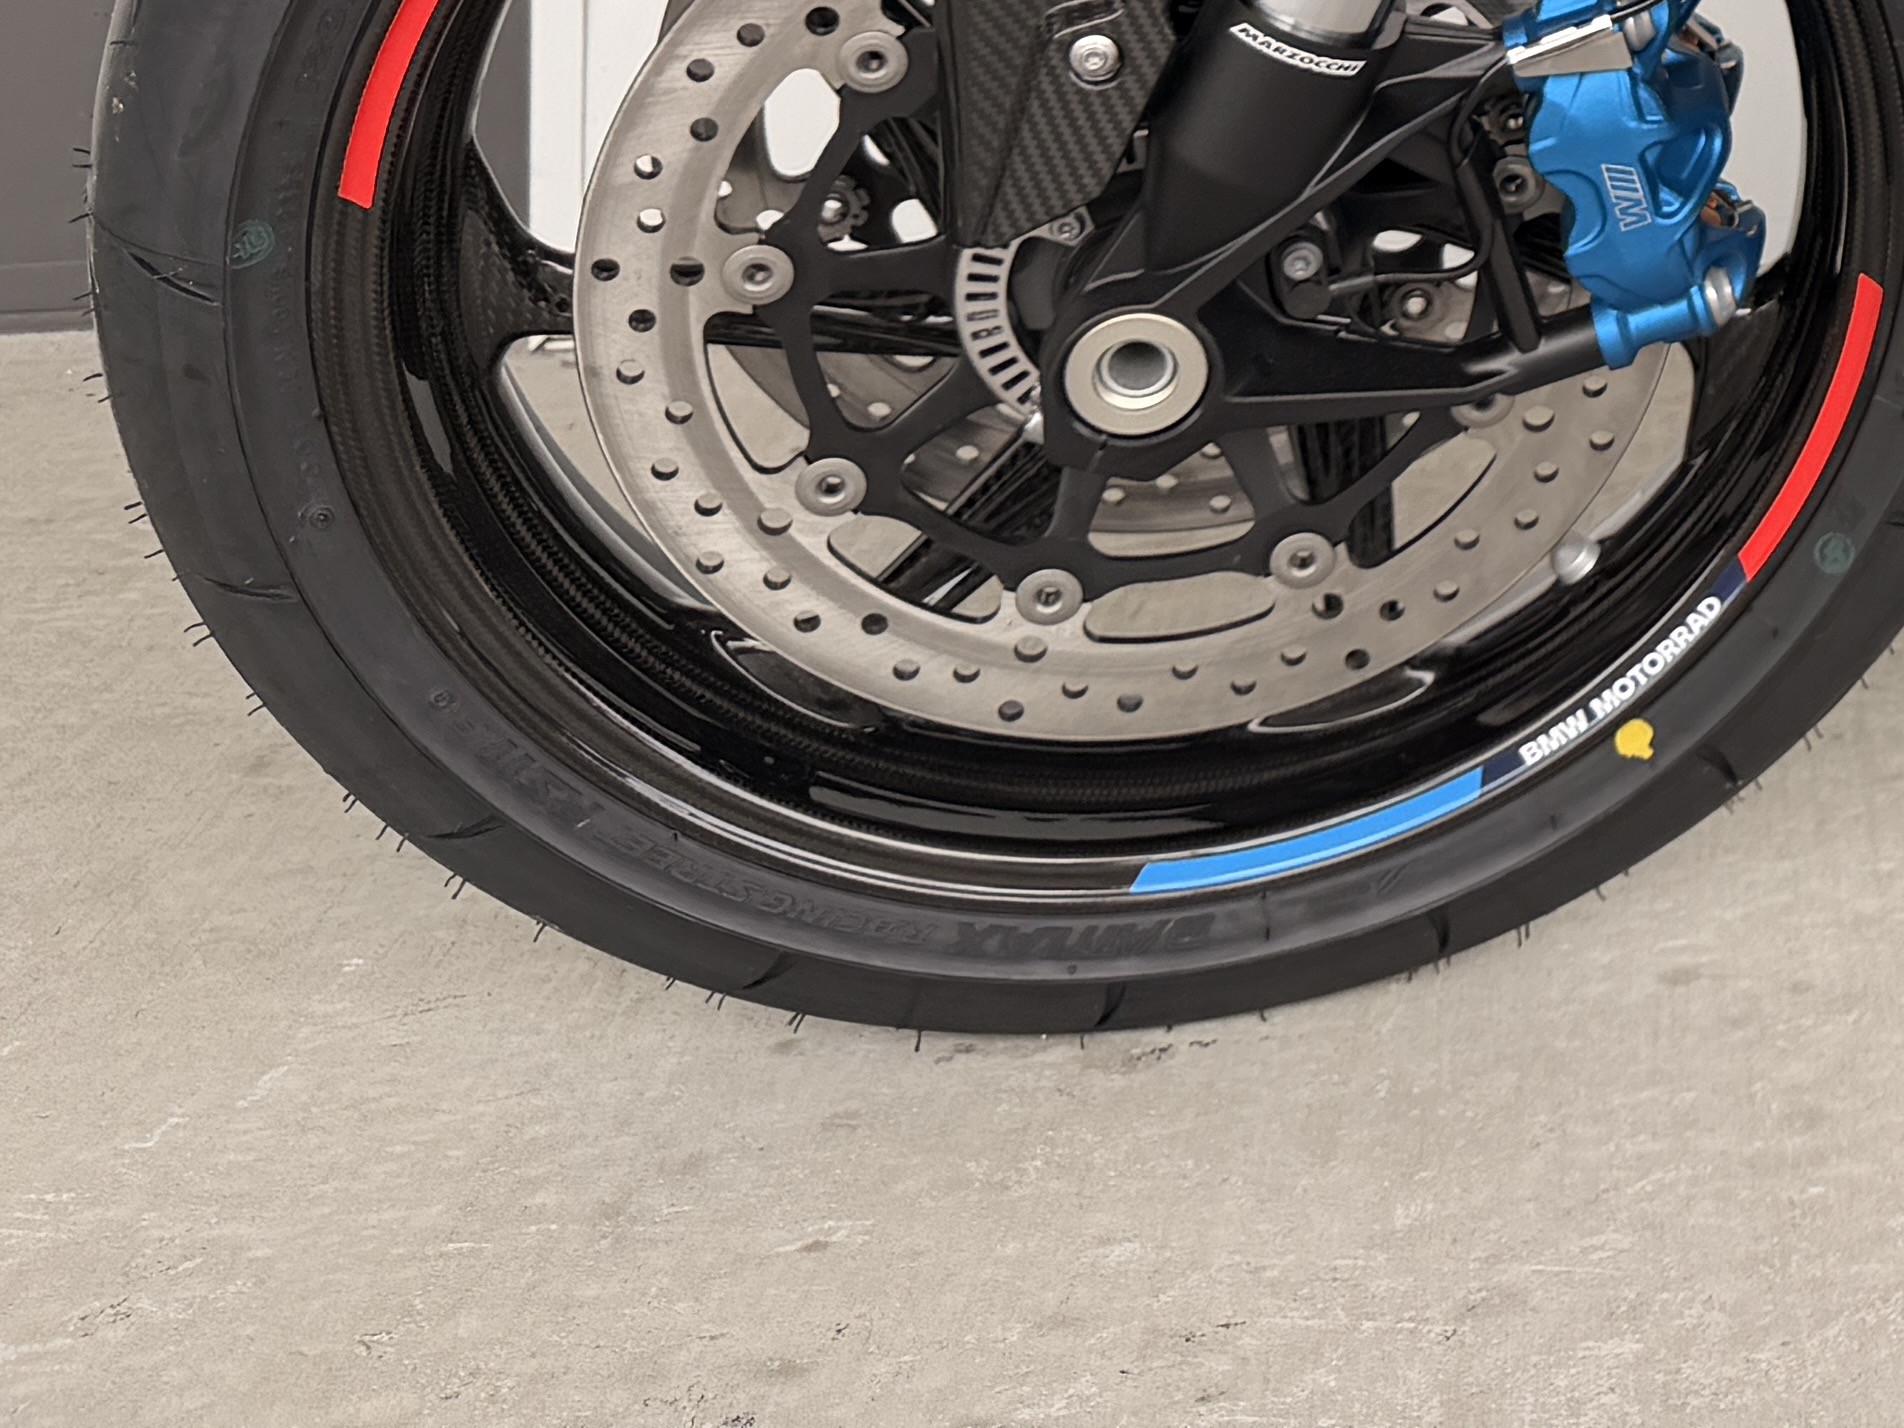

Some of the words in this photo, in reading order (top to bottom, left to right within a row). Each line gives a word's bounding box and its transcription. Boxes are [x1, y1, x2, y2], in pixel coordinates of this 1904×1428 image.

[1238, 27, 1361, 75] MARZOCCHI
[1518, 709, 1591, 767] BMW
[1588, 594, 1724, 729] MOTORRAD
